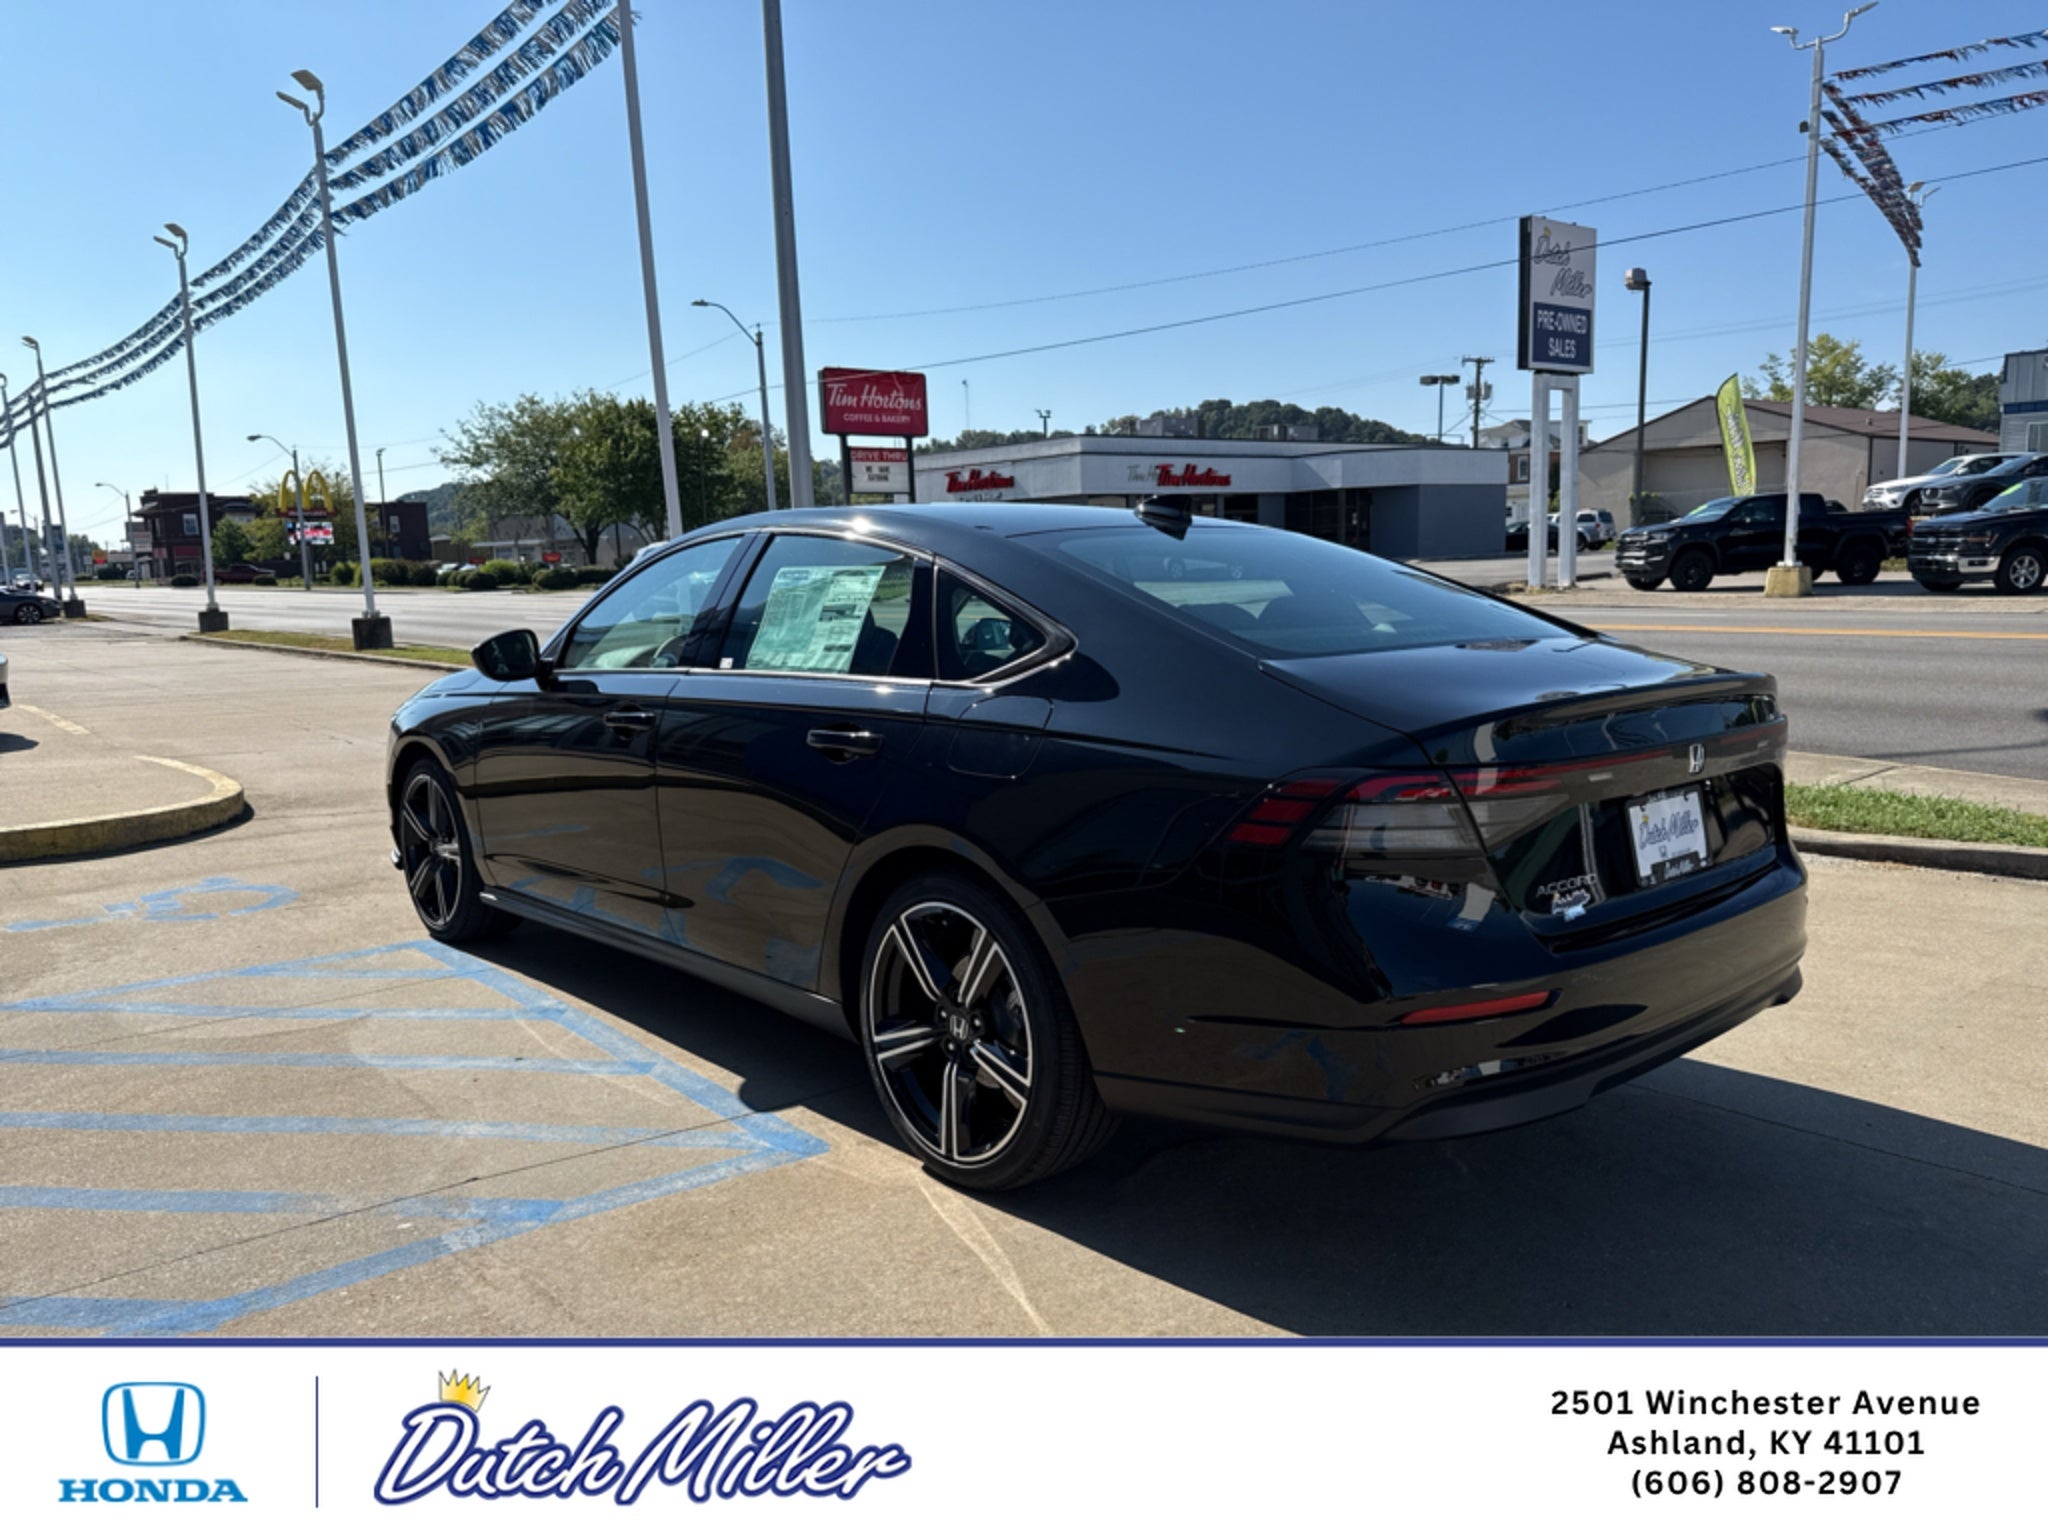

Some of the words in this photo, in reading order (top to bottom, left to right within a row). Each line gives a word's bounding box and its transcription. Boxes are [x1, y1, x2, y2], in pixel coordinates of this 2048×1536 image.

[1537, 309, 1588, 334] PRE-OWNED
[1548, 337, 1576, 359] SALES
[826, 383, 857, 407] Tim
[859, 384, 922, 410] Hortons
[843, 412, 873, 422] COFFEE
[850, 449, 879, 461] DRIVE
[882, 451, 908, 461] THRU
[1535, 873, 1597, 898] ACCORD
